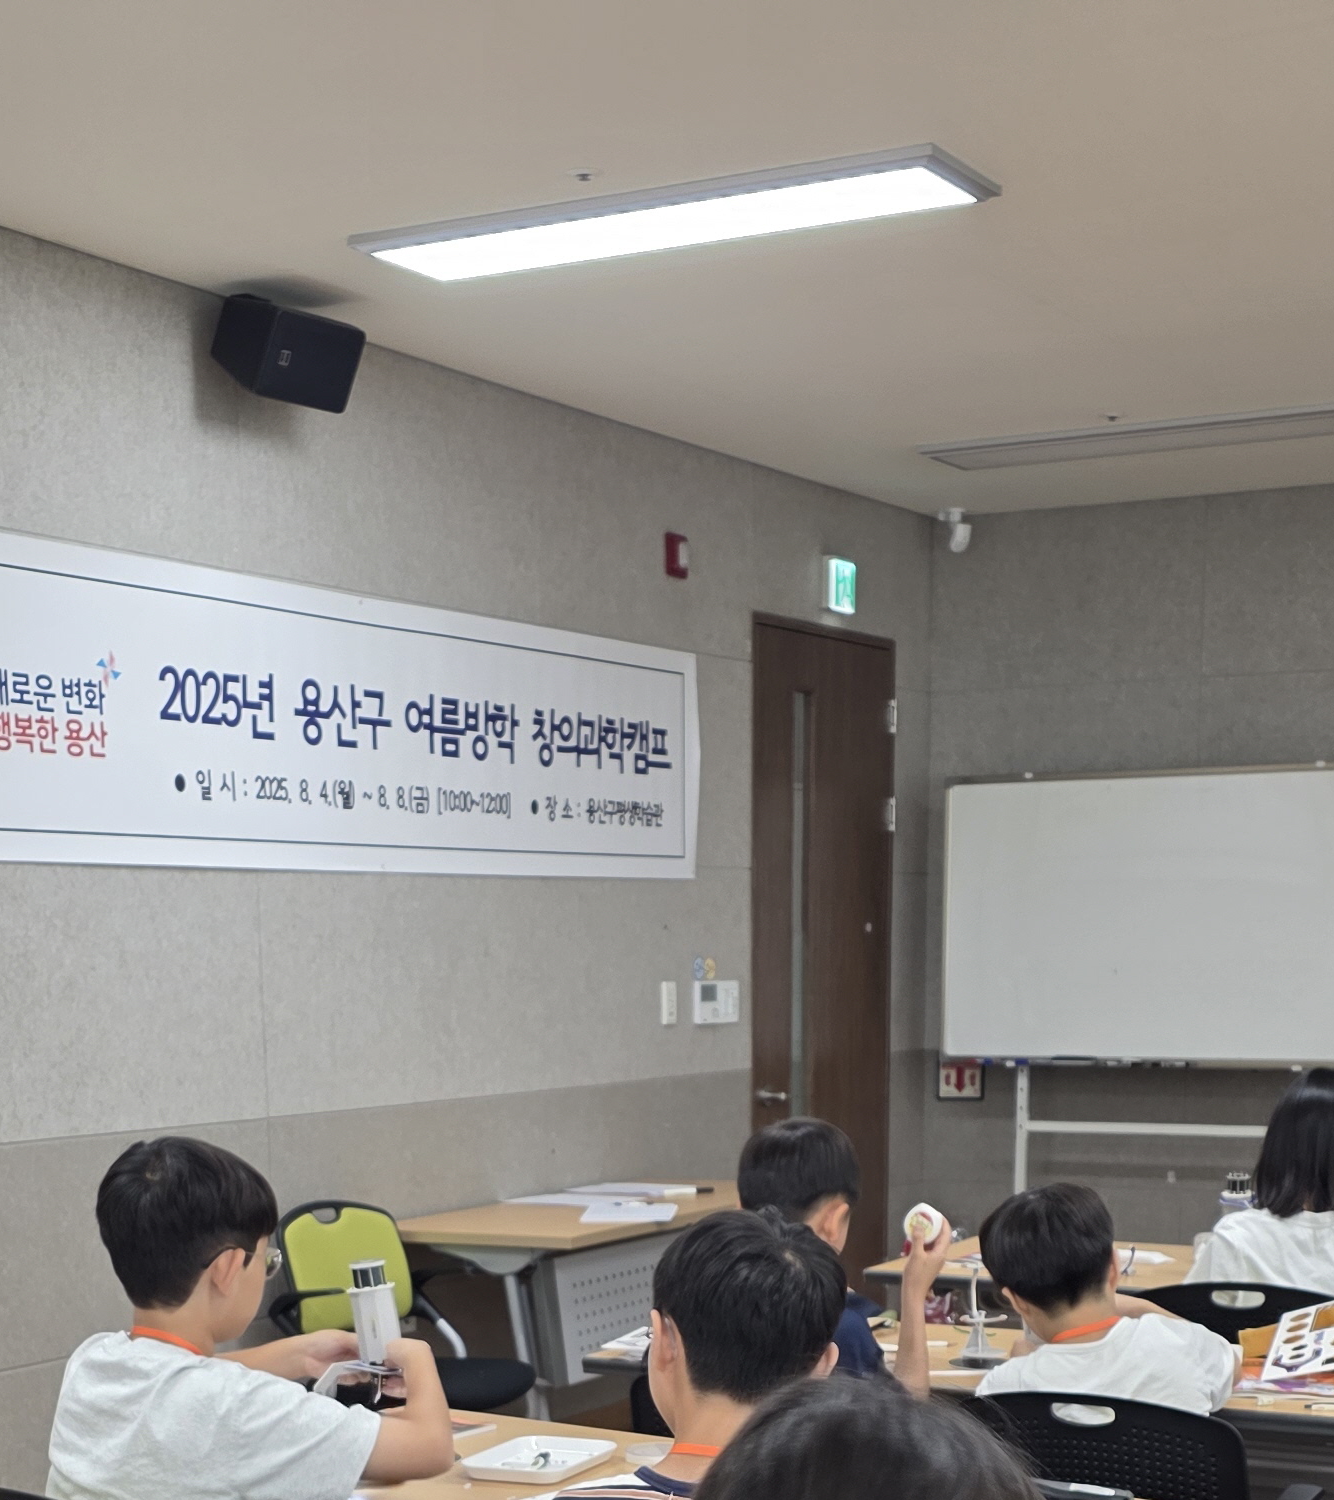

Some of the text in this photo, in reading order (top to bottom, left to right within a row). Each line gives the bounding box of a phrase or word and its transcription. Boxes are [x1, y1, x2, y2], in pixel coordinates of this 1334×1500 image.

[61, 677, 106, 716] 변화
[63, 718, 109, 759] 용산
[158, 664, 673, 776] 2025년 용산구 여름방학 창의과학캠프
[254, 774, 293, 804] 2025.
[436, 785, 512, 820] [10:00~12:00]
[585, 796, 665, 828] 용산구평생학습관
